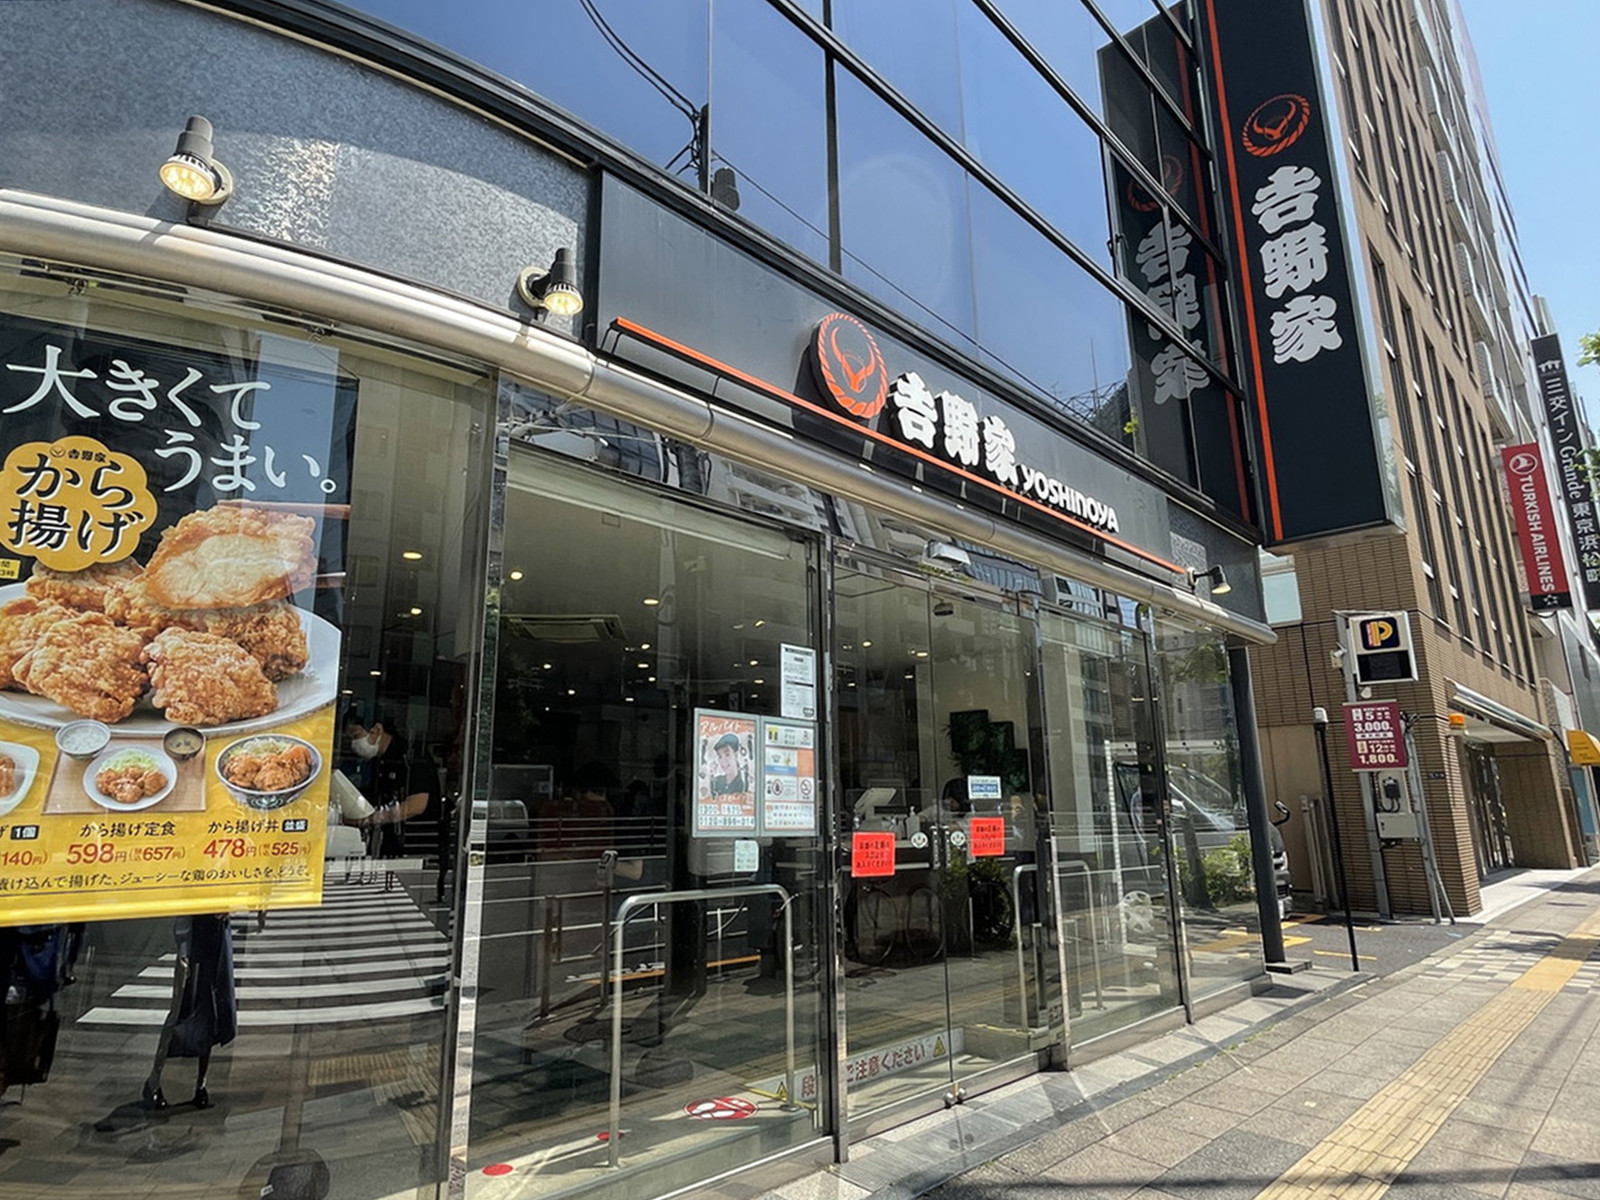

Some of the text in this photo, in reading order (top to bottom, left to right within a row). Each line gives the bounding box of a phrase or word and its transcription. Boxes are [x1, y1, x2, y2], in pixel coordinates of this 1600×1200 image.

[1251, 165, 1343, 364] 吉野家
[2, 344, 272, 430] 大きくて
[890, 371, 1019, 486] 吉野家
[16, 453, 136, 510] から
[154, 429, 337, 493] うまい。
[1560, 446, 1585, 499] Grande
[8, 499, 146, 556] 揚げ
[1018, 463, 1119, 533] YOSHINOYA
[1520, 475, 1555, 592] TURKISH AIRLINES
[80, 820, 177, 838] から揚げ定食
[208, 819, 279, 835] から揚げ丼
